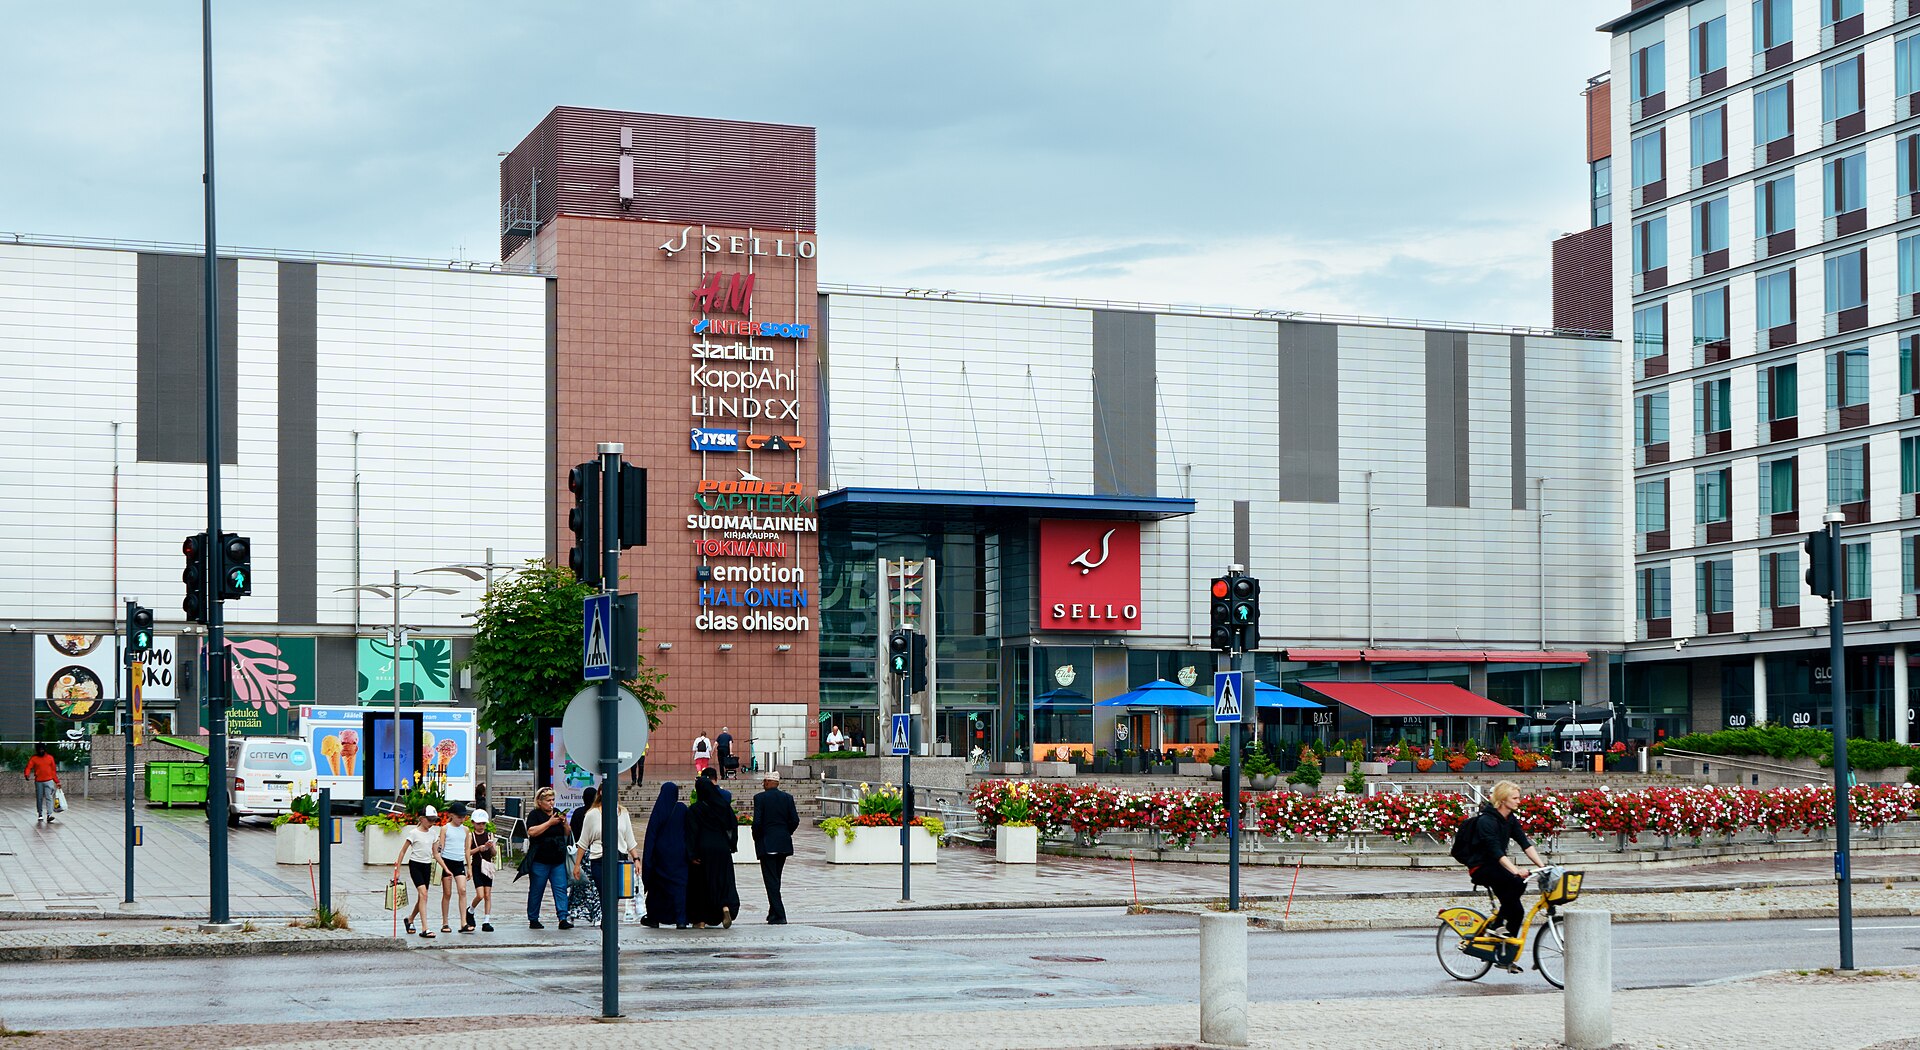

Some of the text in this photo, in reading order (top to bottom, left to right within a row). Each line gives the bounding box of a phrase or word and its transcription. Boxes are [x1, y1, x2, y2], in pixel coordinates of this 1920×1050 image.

[706, 234, 816, 259] SELLO
[692, 270, 756, 316] H&M
[710, 319, 811, 339] INTERSPORT
[691, 341, 774, 362] stadium
[690, 364, 795, 393] KappAhl
[691, 395, 799, 420] LINDEX
[700, 433, 737, 446] JYSK
[697, 479, 803, 496] POWER
[714, 493, 816, 513] APTEEKKI
[687, 514, 817, 532] SUOMALAINEN
[723, 531, 780, 540] KIRJAKAUPPA
[693, 539, 788, 558] TOKMANNI
[713, 562, 805, 583] emotion
[698, 587, 808, 608] HALONEN
[1053, 603, 1138, 619] SELLO
[695, 611, 809, 631] clas ohlson
[124, 648, 172, 666] OMO
[1729, 714, 1746, 726] GLO
[1792, 712, 1811, 724] GLO
[249, 751, 289, 760] CATEVA
